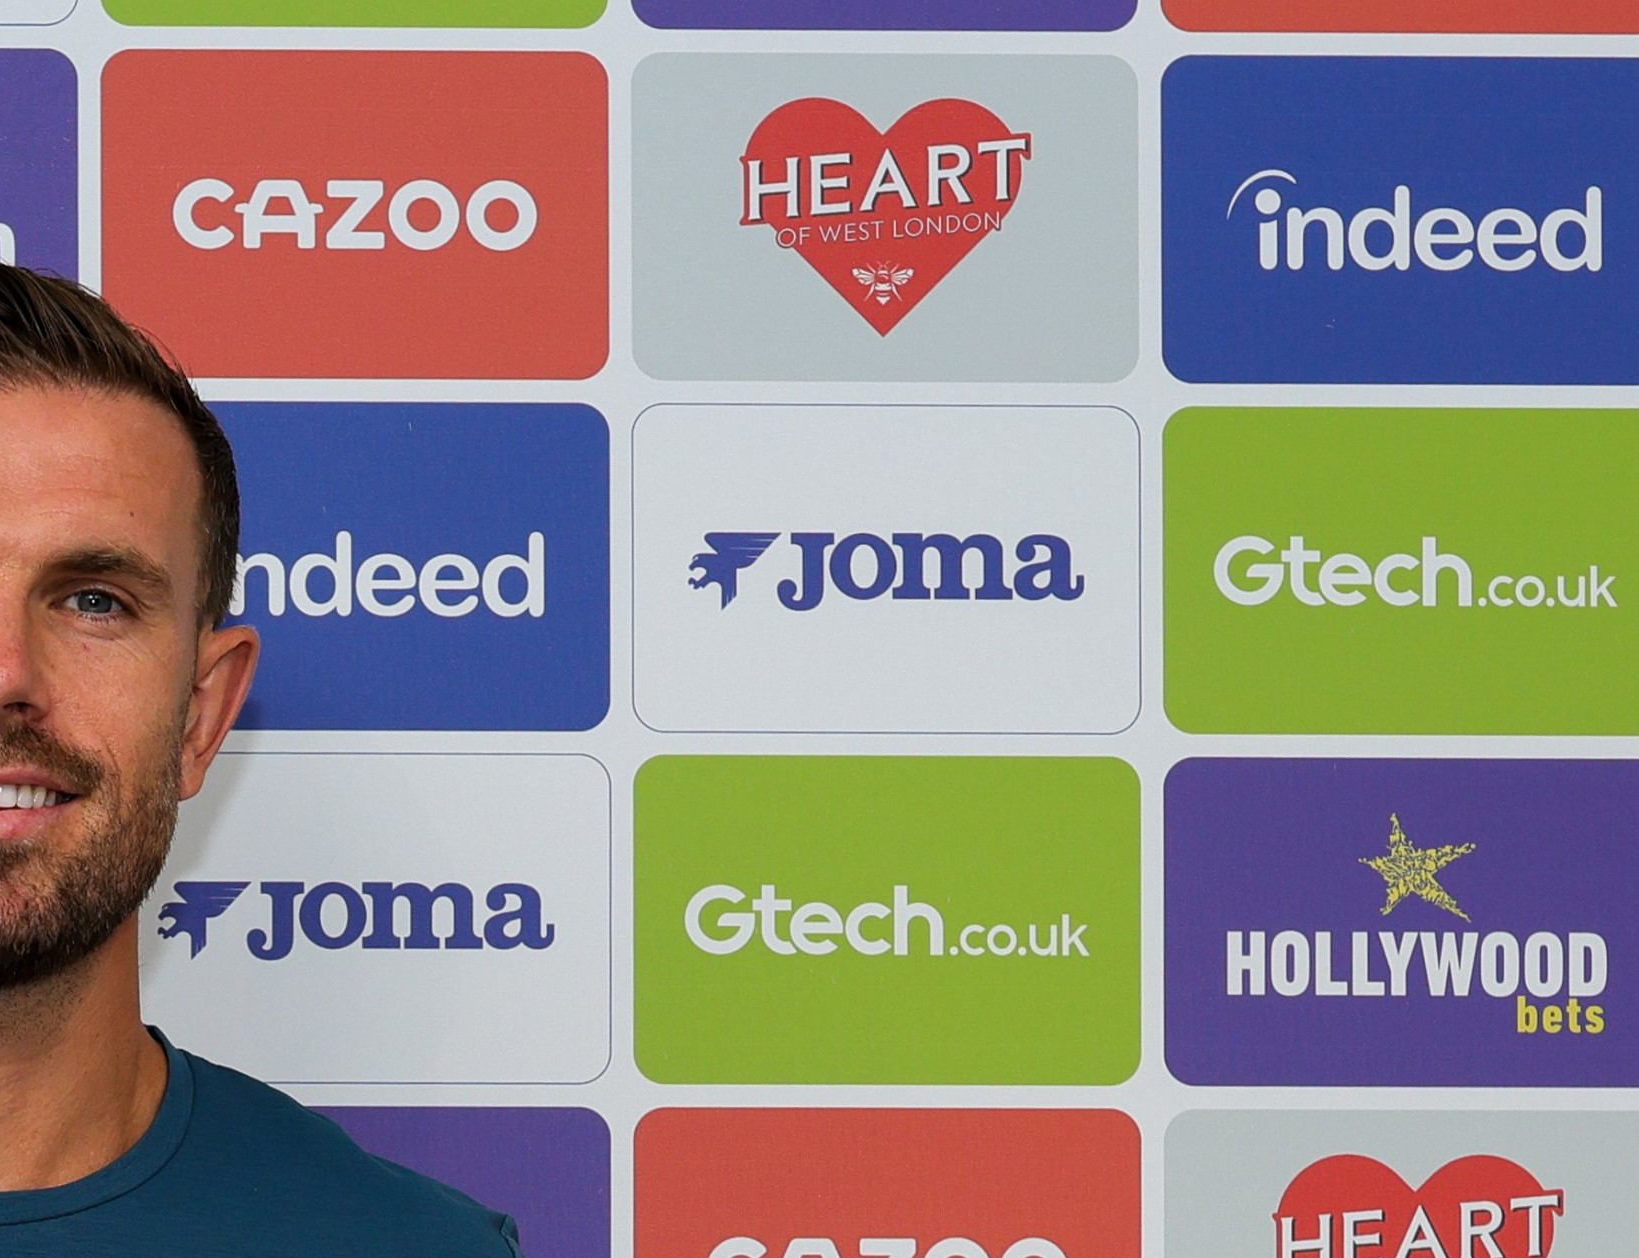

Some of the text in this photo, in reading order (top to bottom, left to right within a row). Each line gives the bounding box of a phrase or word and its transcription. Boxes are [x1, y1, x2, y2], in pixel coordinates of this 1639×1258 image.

[172, 178, 538, 252] CAZOO
[748, 138, 1028, 222] HEART
[776, 211, 1001, 248] OF WEST LONDON
[1227, 169, 1603, 272] indeed
[228, 530, 545, 618] ndeed
[1213, 535, 1618, 608] Gtech.co.uk
[684, 884, 1090, 957] Gtech.co.uk
[1226, 930, 1608, 998] HOLLYWOOD
[1516, 996, 1605, 1034] bets
